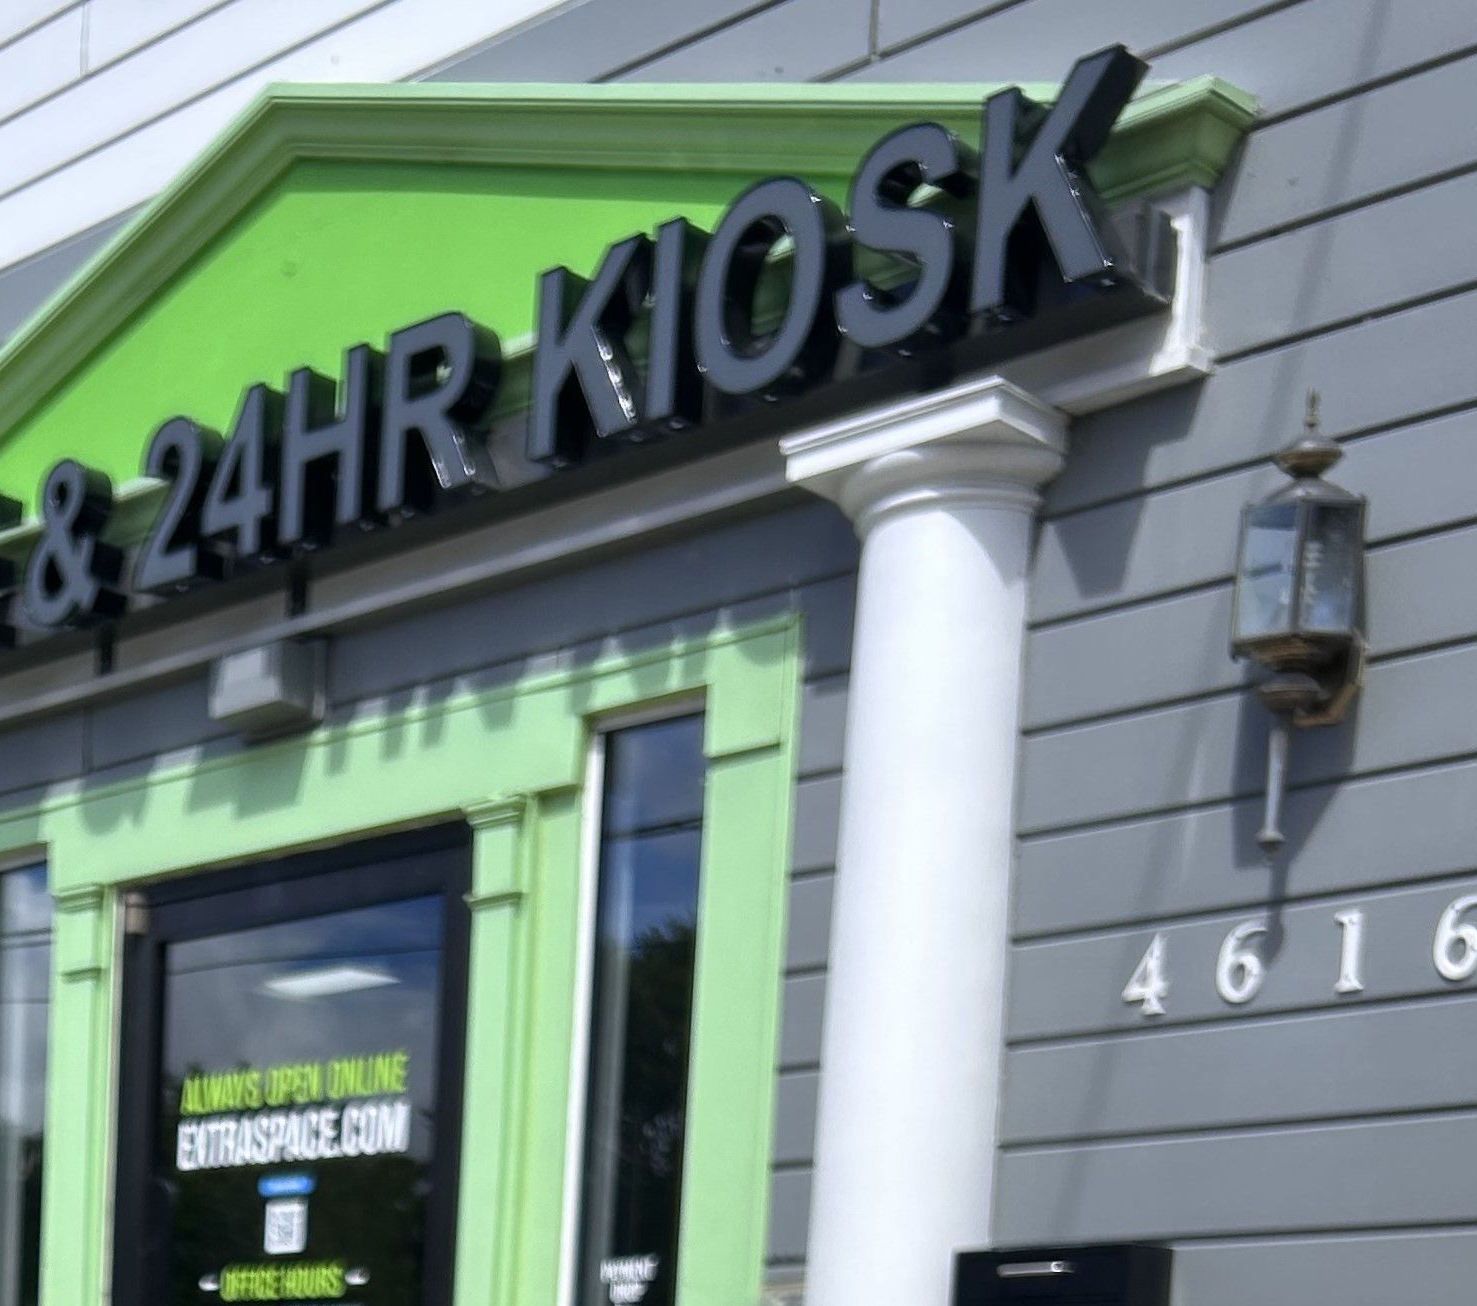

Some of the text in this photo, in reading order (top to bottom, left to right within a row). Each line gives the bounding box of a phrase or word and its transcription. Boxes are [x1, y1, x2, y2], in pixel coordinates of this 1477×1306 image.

[24, 458, 98, 628] &
[134, 311, 476, 592] 24HR
[527, 42, 1126, 462] KIOSK
[1121, 895, 1477, 1016] 4616
[180, 1051, 409, 1116] ALWAYS OPEN ONLINE
[176, 1099, 411, 1171] EXTRASPACE.COM
